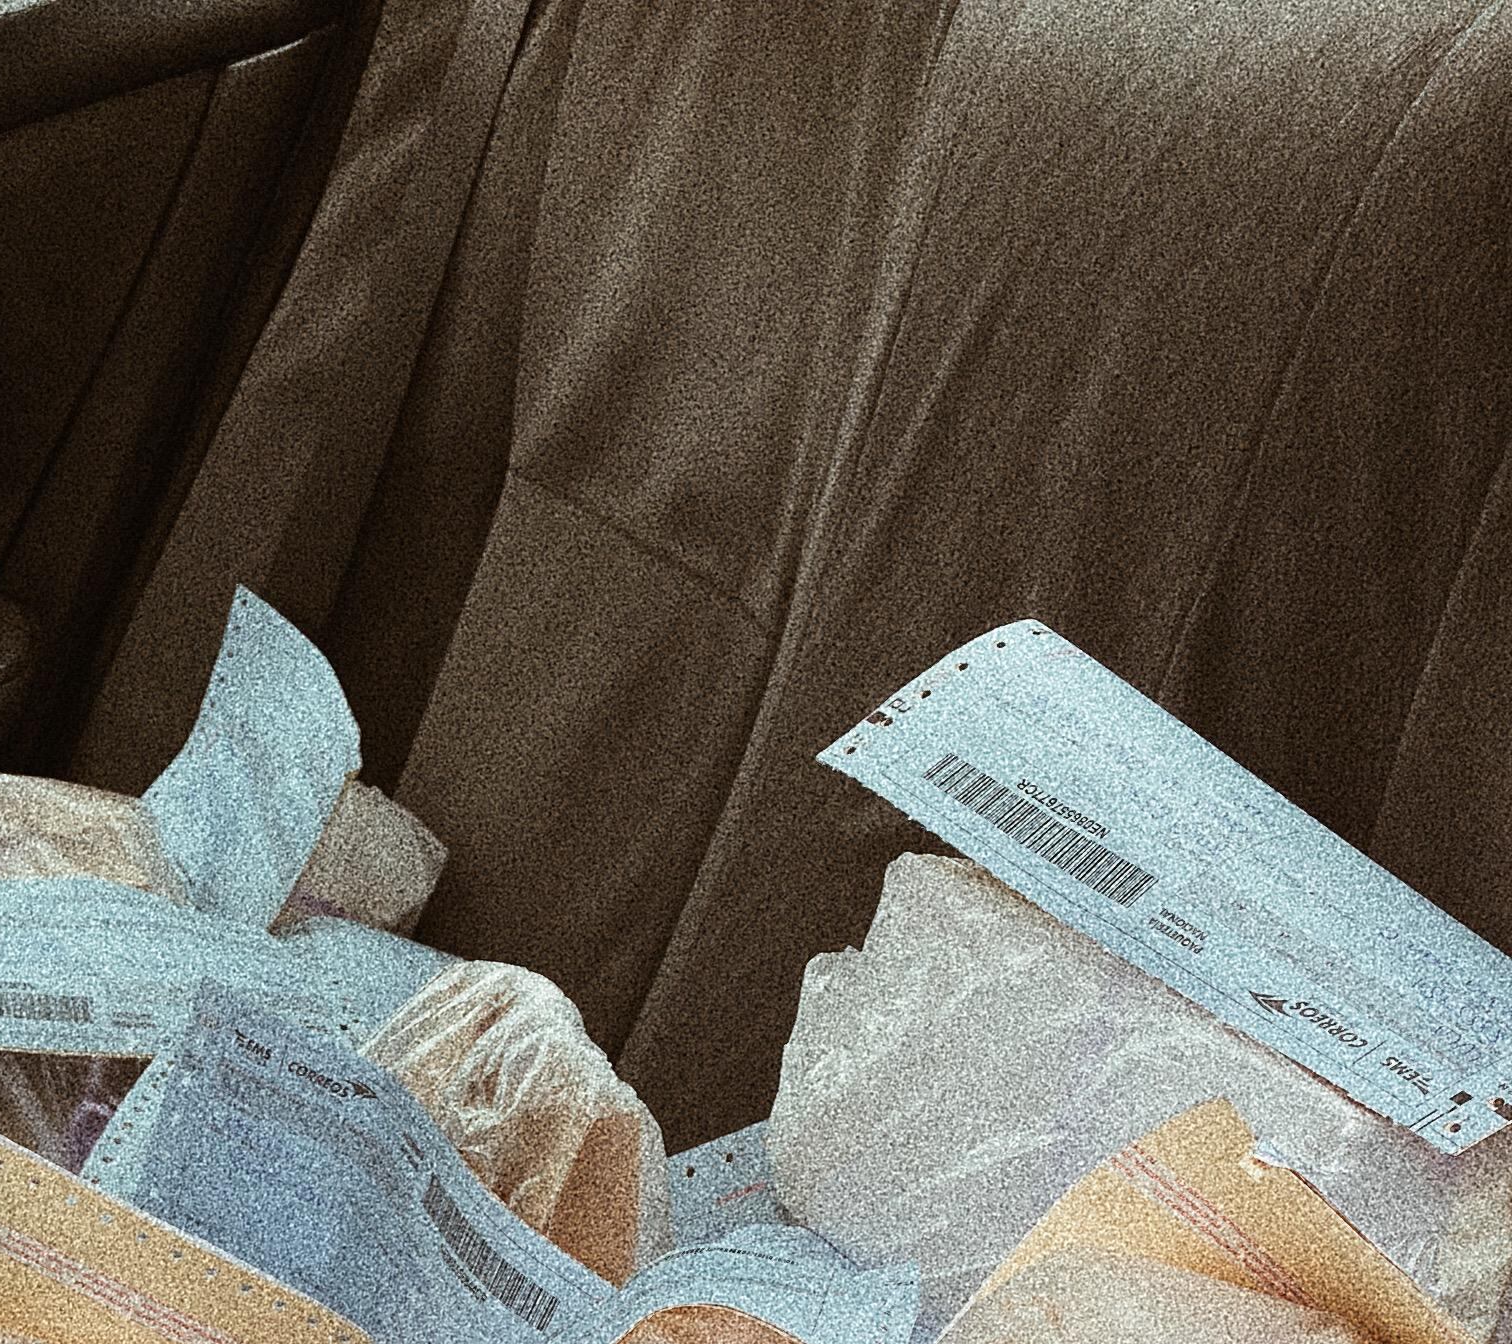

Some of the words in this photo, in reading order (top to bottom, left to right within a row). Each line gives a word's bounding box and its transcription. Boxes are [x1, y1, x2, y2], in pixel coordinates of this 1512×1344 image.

[1016, 777, 1109, 842] NE086557677CR
[1157, 904, 1208, 944] NACIONAL
[1290, 992, 1369, 1055] CORREOS
[245, 1040, 273, 1059] EMS
[284, 1059, 352, 1098] CORREOS
[1380, 1051, 1420, 1085] EMS
